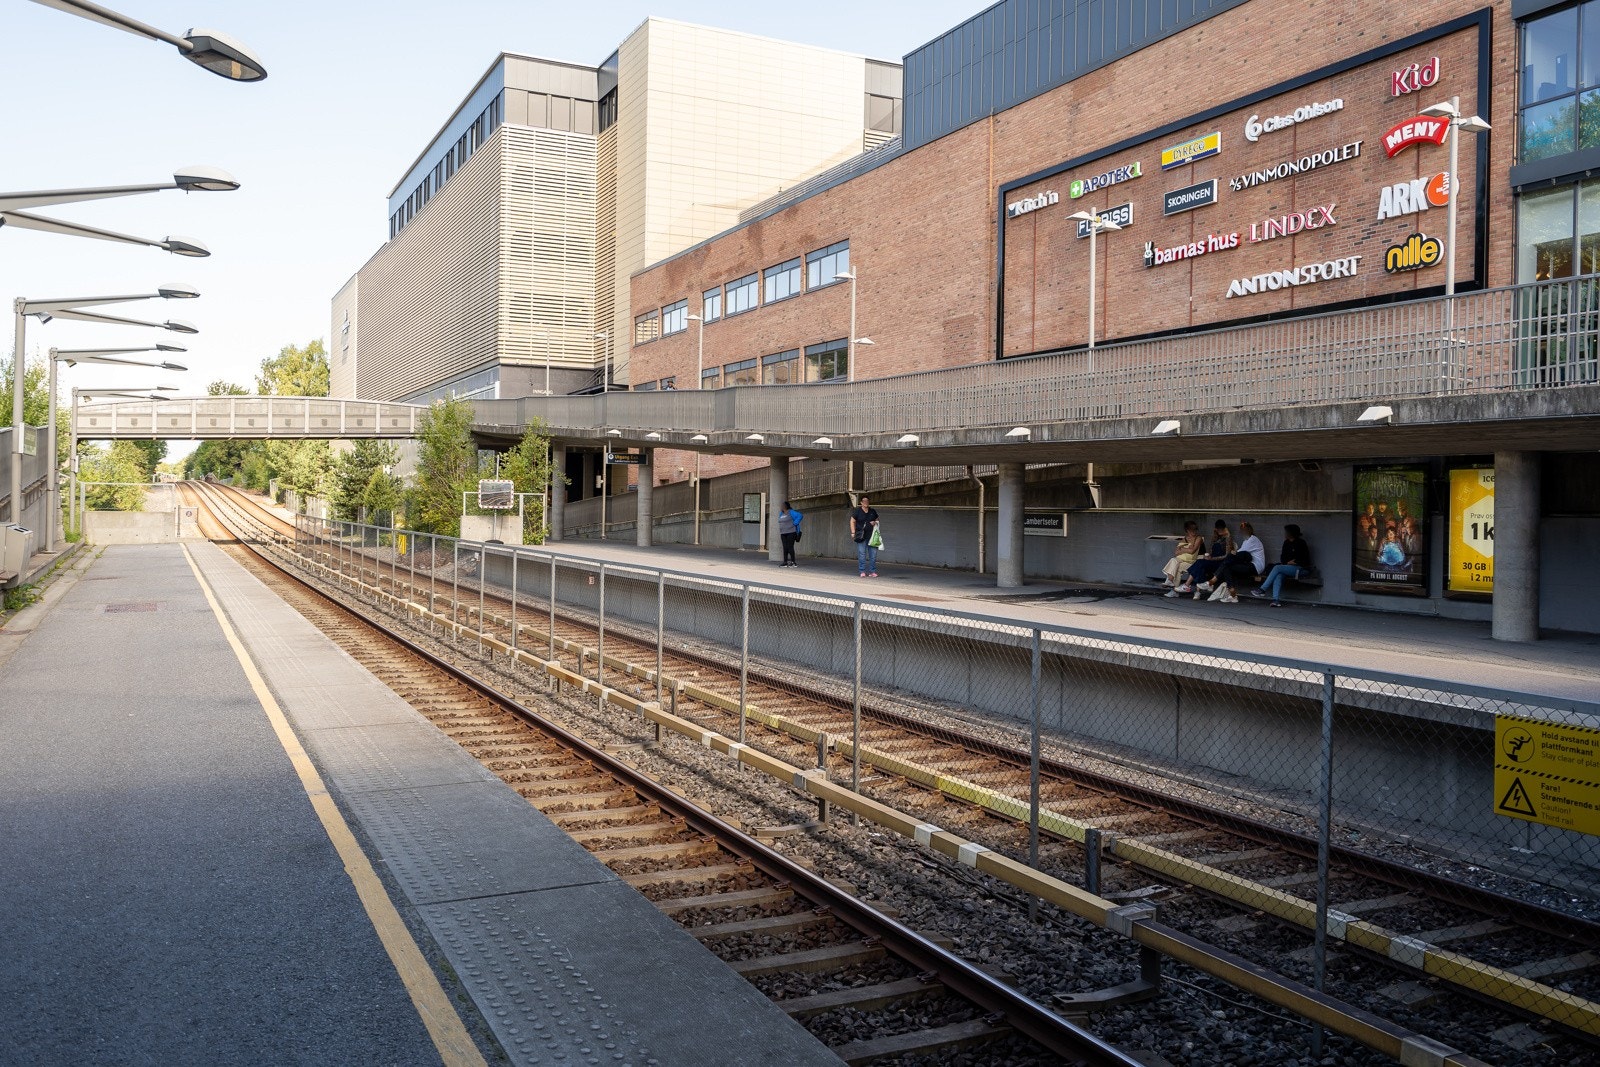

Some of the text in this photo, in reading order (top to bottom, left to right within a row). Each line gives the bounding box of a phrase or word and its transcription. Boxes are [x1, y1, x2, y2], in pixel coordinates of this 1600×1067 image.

[1391, 57, 1440, 97] Kid
[1385, 121, 1441, 149] MENY
[1242, 140, 1364, 189] VINMONOPOLET
[1167, 187, 1211, 208] SKORINGEN
[1377, 177, 1429, 220] ARK
[1078, 207, 1129, 234] FLRISS
[1249, 203, 1337, 244] LINDEX
[1154, 230, 1241, 266] barnas hus
[1386, 235, 1439, 270] nille
[1471, 522, 1478, 540] 1
[1462, 562, 1473, 570] 30
[1474, 562, 1487, 571] GB
[1475, 574, 1481, 582] 2
[1541, 731, 1600, 748] Hold avstand til
[1541, 741, 1593, 757] plattformkant
[1541, 750, 1556, 761] Stay
[1557, 753, 1575, 763] clear
[1576, 756, 1584, 765] of
[1540, 782, 1561, 793] Fare!
[1540, 792, 1593, 810] Strømførende
[1540, 802, 1571, 814] Caution!
[1541, 812, 1574, 825] Third rail
